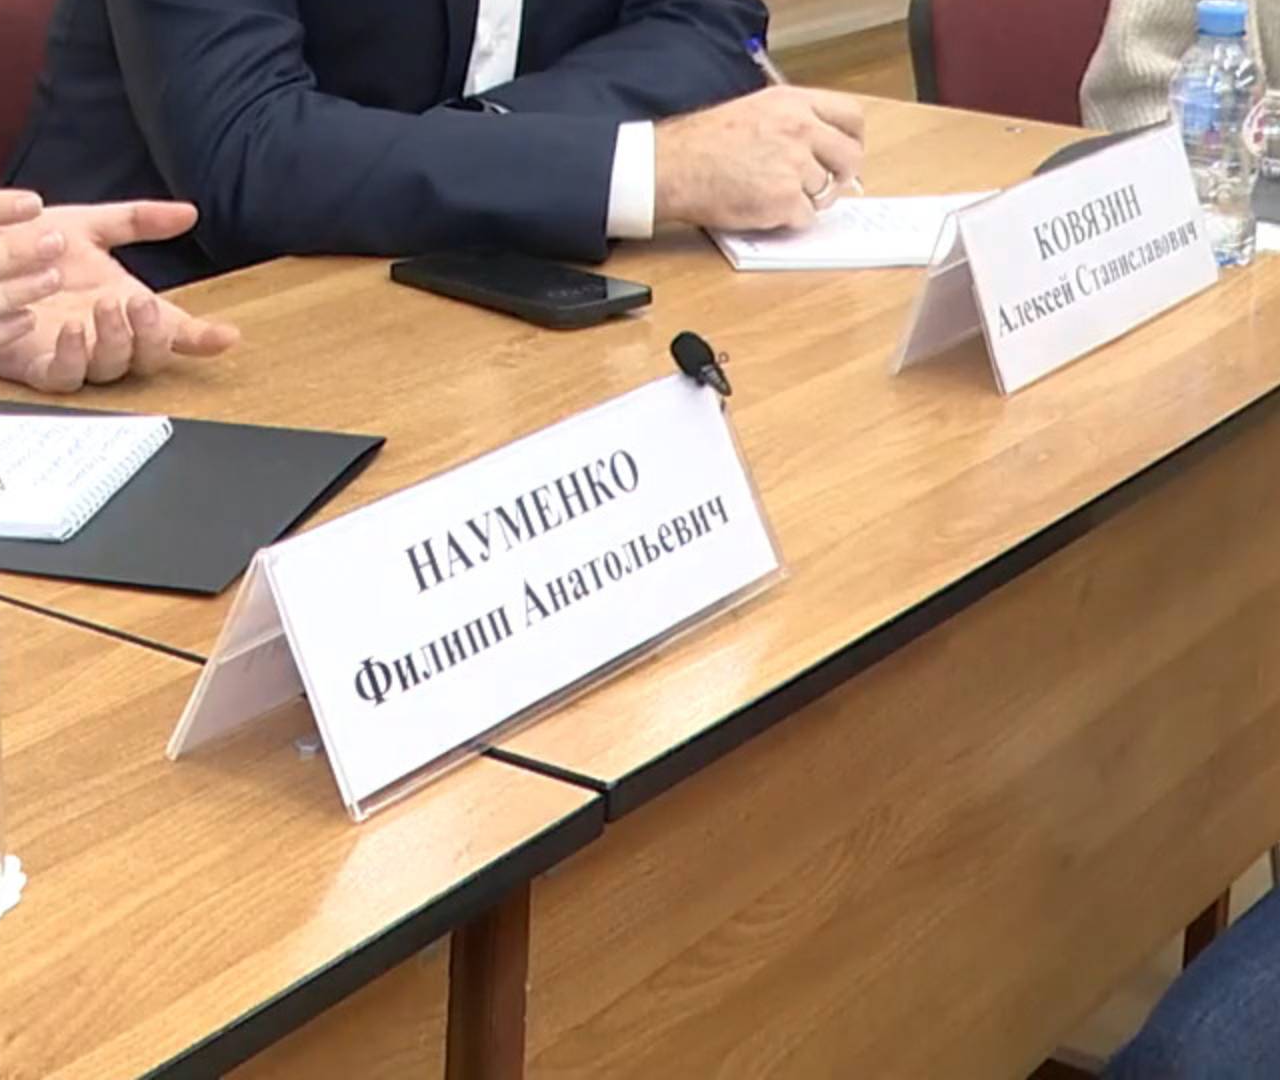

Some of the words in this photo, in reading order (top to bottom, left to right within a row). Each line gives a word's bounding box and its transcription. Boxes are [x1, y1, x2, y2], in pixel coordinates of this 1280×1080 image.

[998, 273, 1076, 338] Алексей
[1076, 220, 1200, 297] Станиславович
[1032, 183, 1143, 261] КОВЯЗИН
[403, 449, 640, 593] НАУМЕНКО
[353, 604, 514, 707] Филипп
[523, 494, 731, 627] Анатольевич
